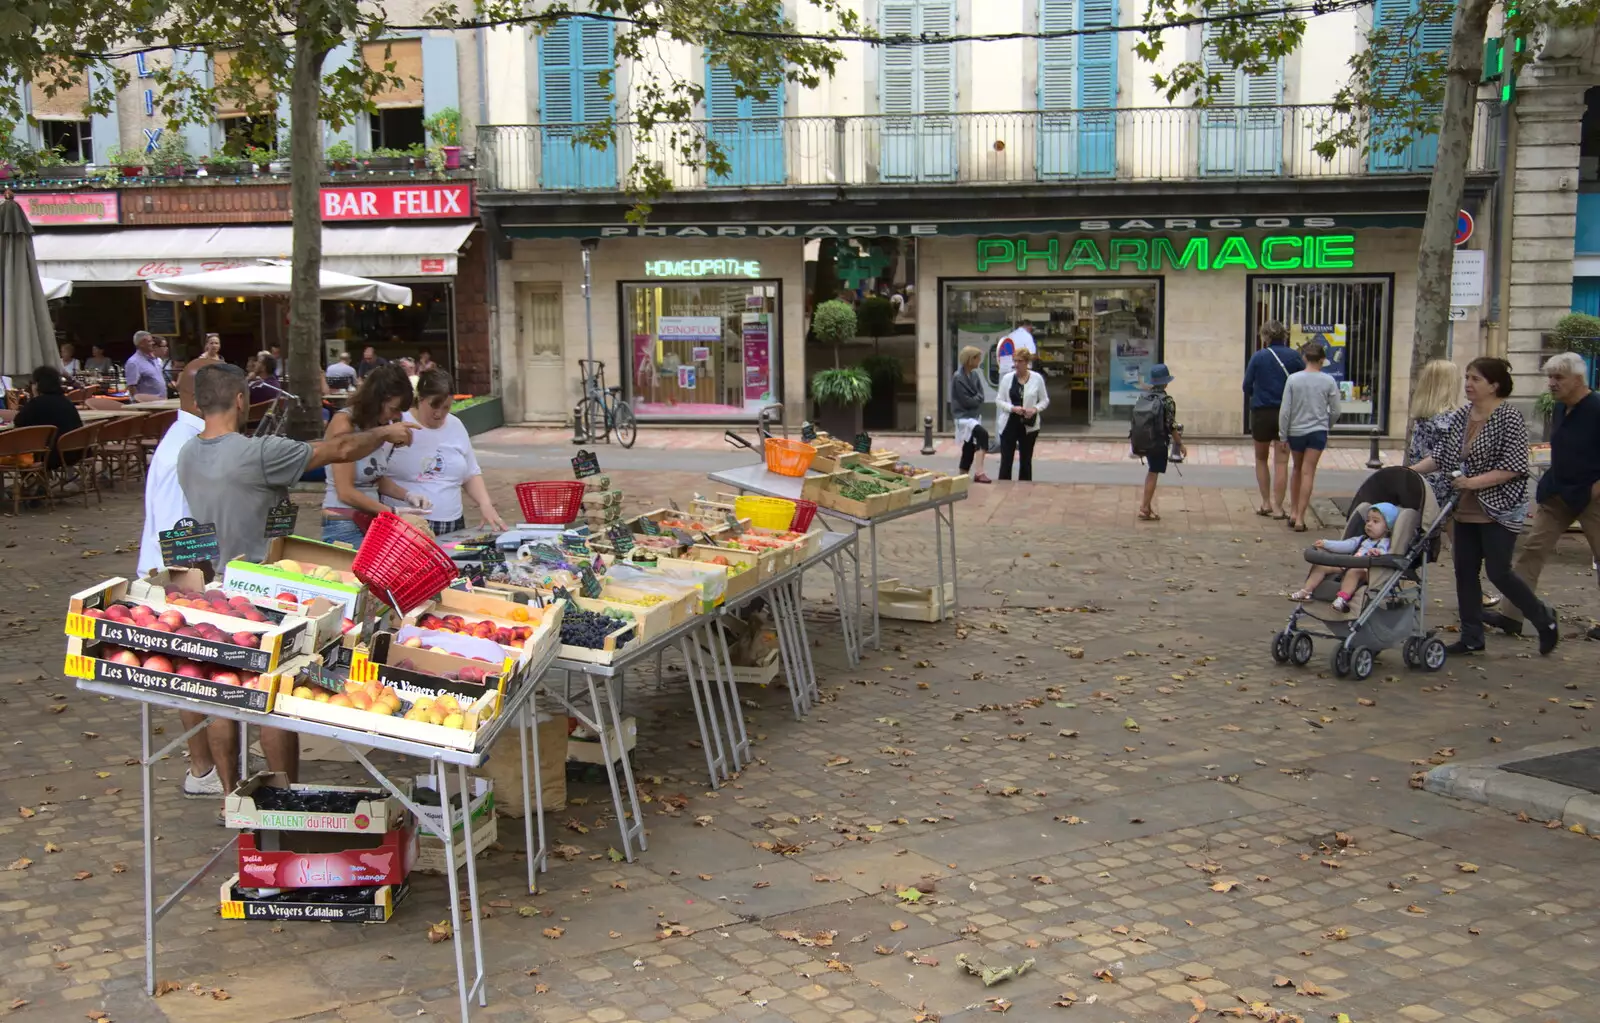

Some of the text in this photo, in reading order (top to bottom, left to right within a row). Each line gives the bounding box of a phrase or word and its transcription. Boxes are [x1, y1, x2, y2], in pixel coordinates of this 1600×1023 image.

[325, 189, 462, 216] BAR FELIX
[601, 224, 939, 237] PHARMACIE
[1080, 217, 1336, 231] SARCOS
[976, 235, 1355, 272] PHARMACIE
[660, 325, 717, 335] VEINOFLUX
[180, 519, 194, 528] 1kg
[229, 579, 270, 596] MELONS
[101, 623, 219, 659] Les Vergers Catalans
[101, 663, 218, 699] Les Vergers Catalans
[307, 818, 320, 828] du
[321, 817, 348, 829] FRUIT
[249, 904, 267, 915] Les
[270, 905, 303, 919] Vergers
[305, 905, 344, 918] Catalans
